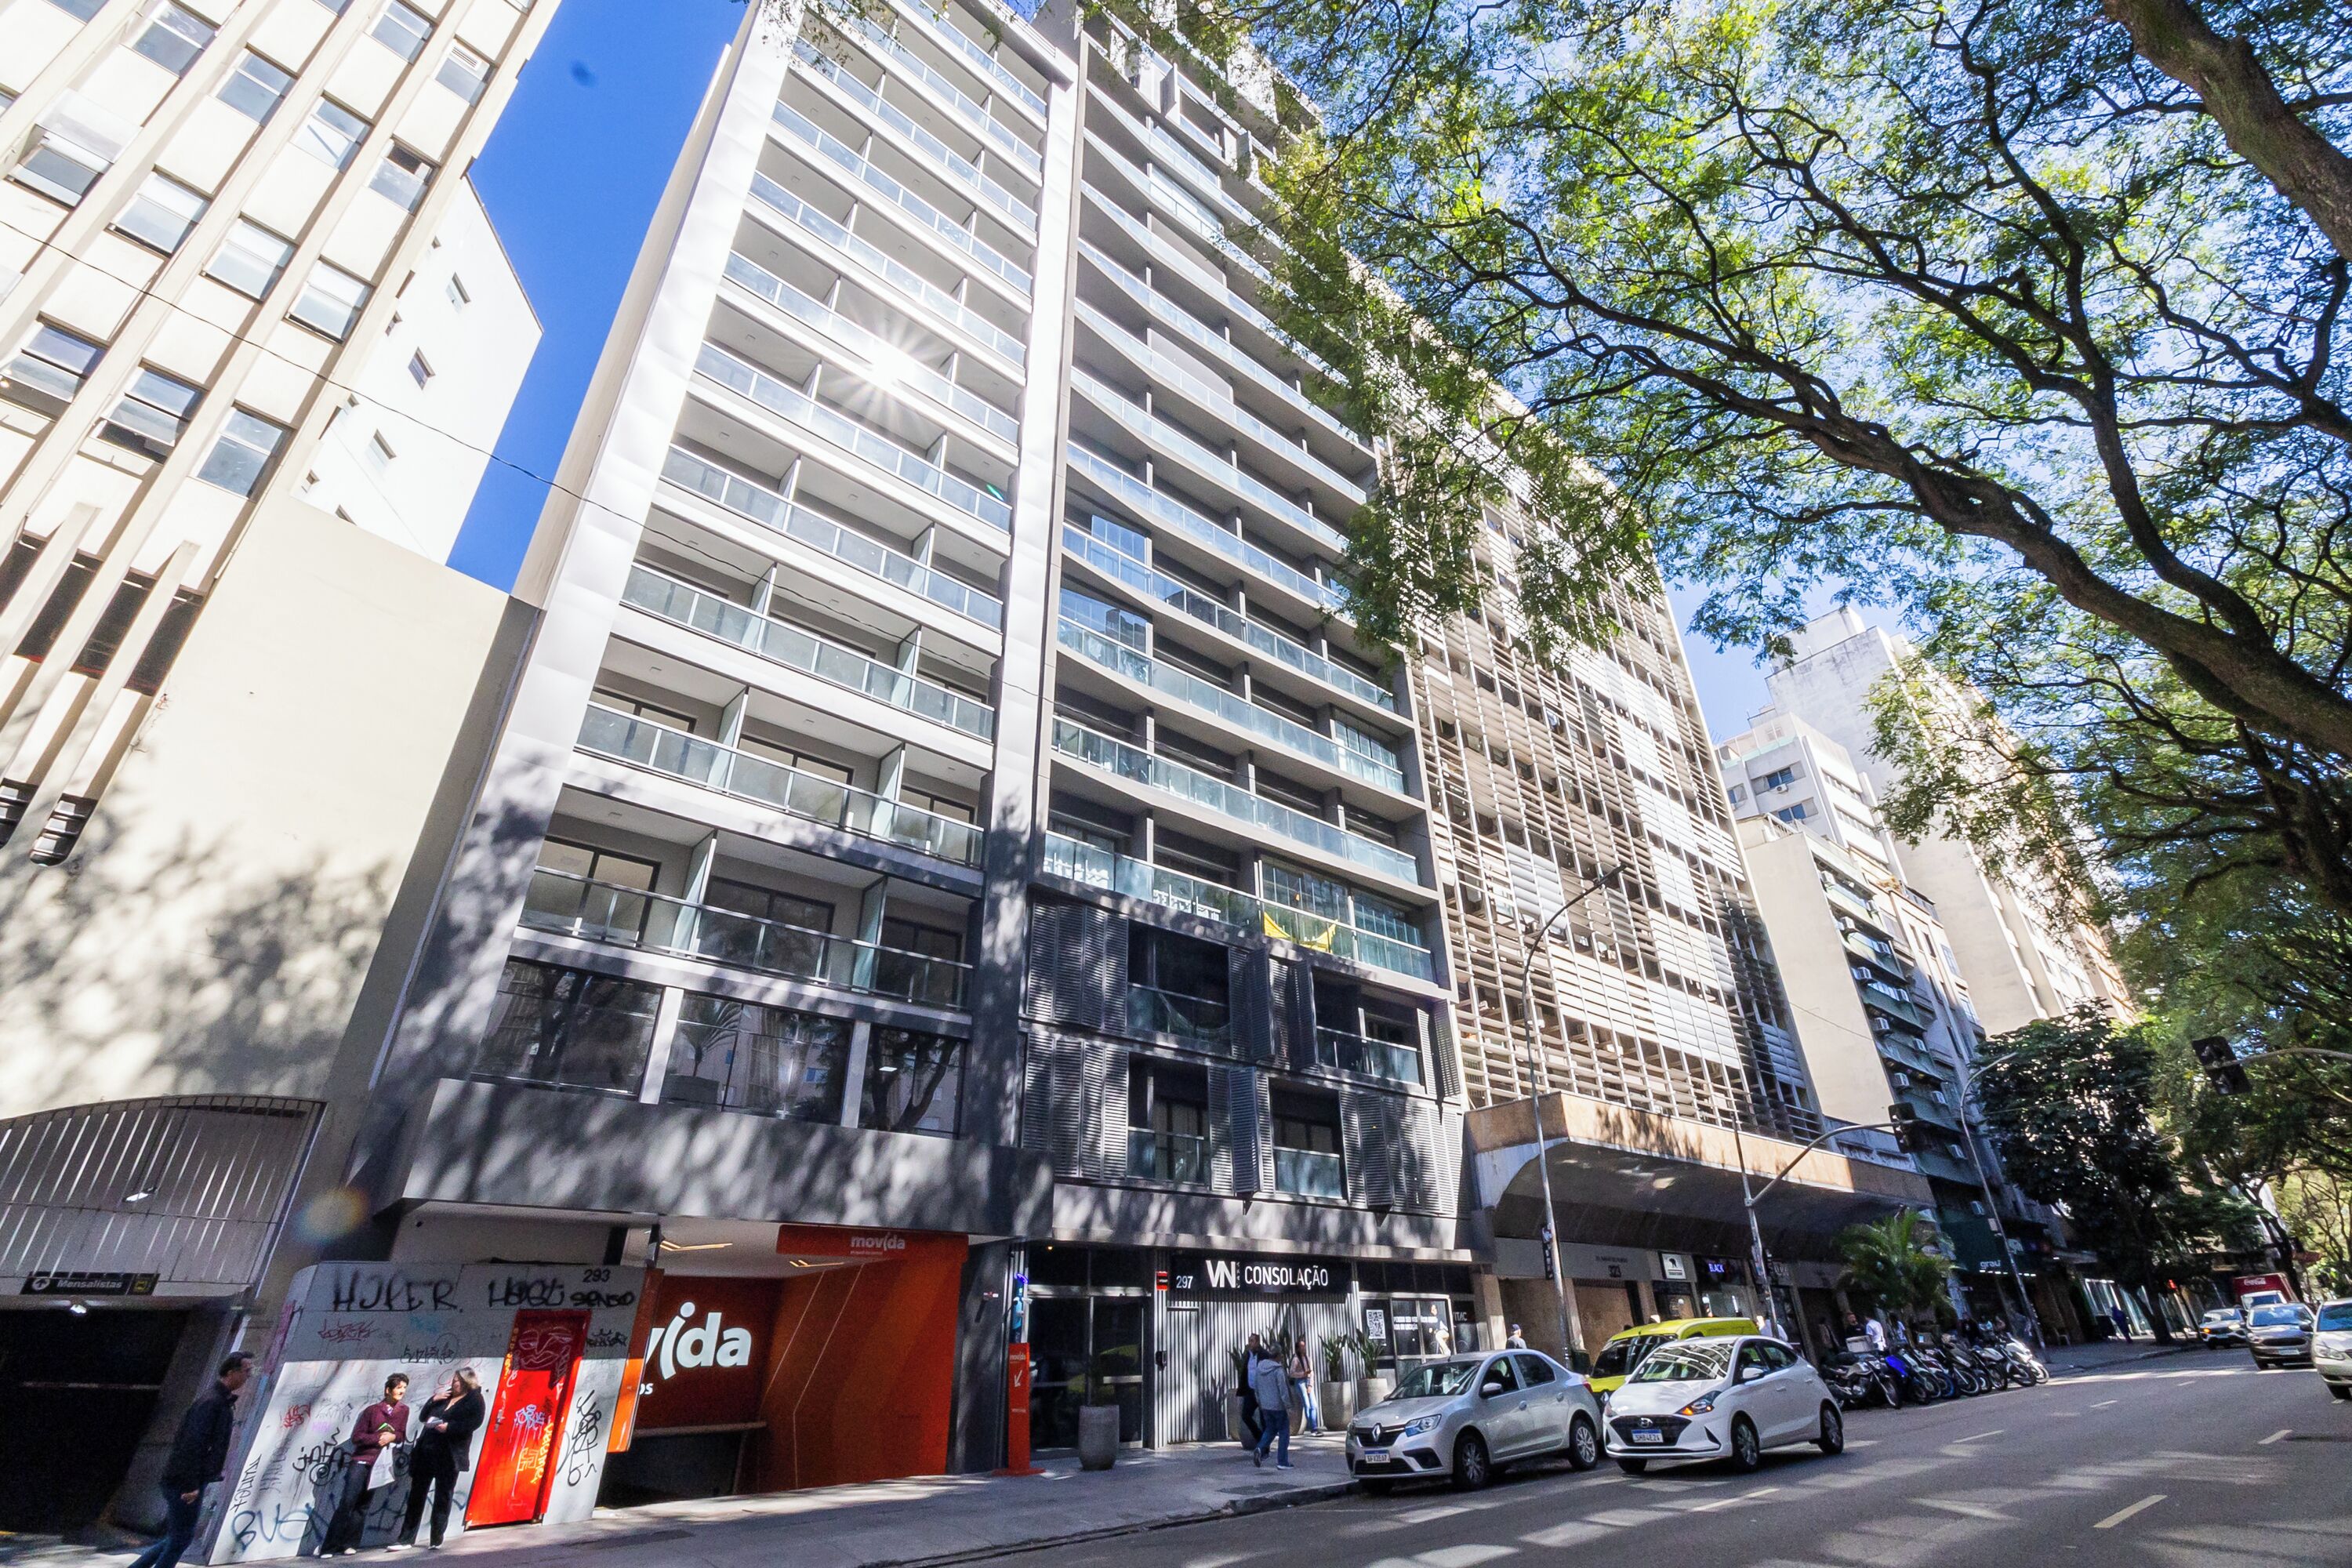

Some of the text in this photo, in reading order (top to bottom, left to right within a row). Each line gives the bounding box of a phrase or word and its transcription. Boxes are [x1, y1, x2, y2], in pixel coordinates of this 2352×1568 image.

[850, 1232, 906, 1251] movida
[1708, 1263, 1725, 1273] BLACK
[583, 1269, 611, 1283] 293
[1176, 1275, 1193, 1289] 297
[1244, 1265, 1329, 1290] CONSOLAÇÃO
[56, 1279, 122, 1289] Mensalistas
